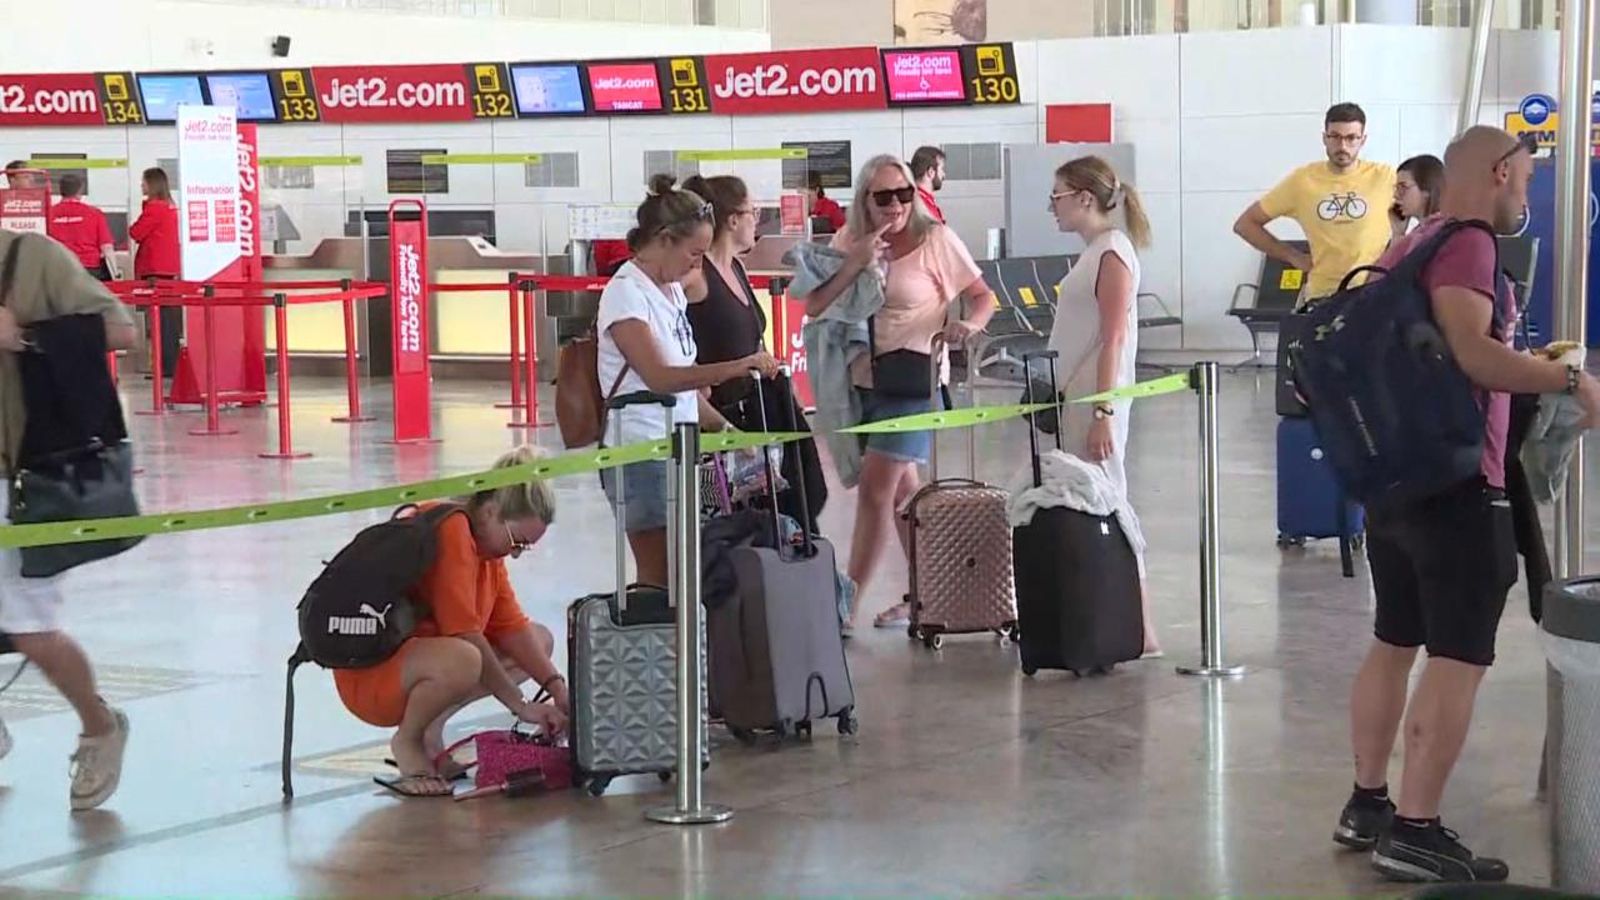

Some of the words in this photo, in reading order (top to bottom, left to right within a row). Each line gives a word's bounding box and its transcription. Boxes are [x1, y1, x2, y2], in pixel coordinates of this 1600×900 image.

[321, 77, 466, 109] Jet2.com
[713, 63, 877, 100] Jet2.com
[971, 77, 1018, 102] 130
[280, 98, 317, 121] 133
[473, 93, 513, 118] 132
[668, 88, 709, 112] 131
[103, 102, 141, 123] 134
[184, 119, 233, 133] Jet2.com
[186, 184, 235, 196] Information
[407, 244, 420, 352] Jet2.com
[328, 616, 377, 635] PUMA
